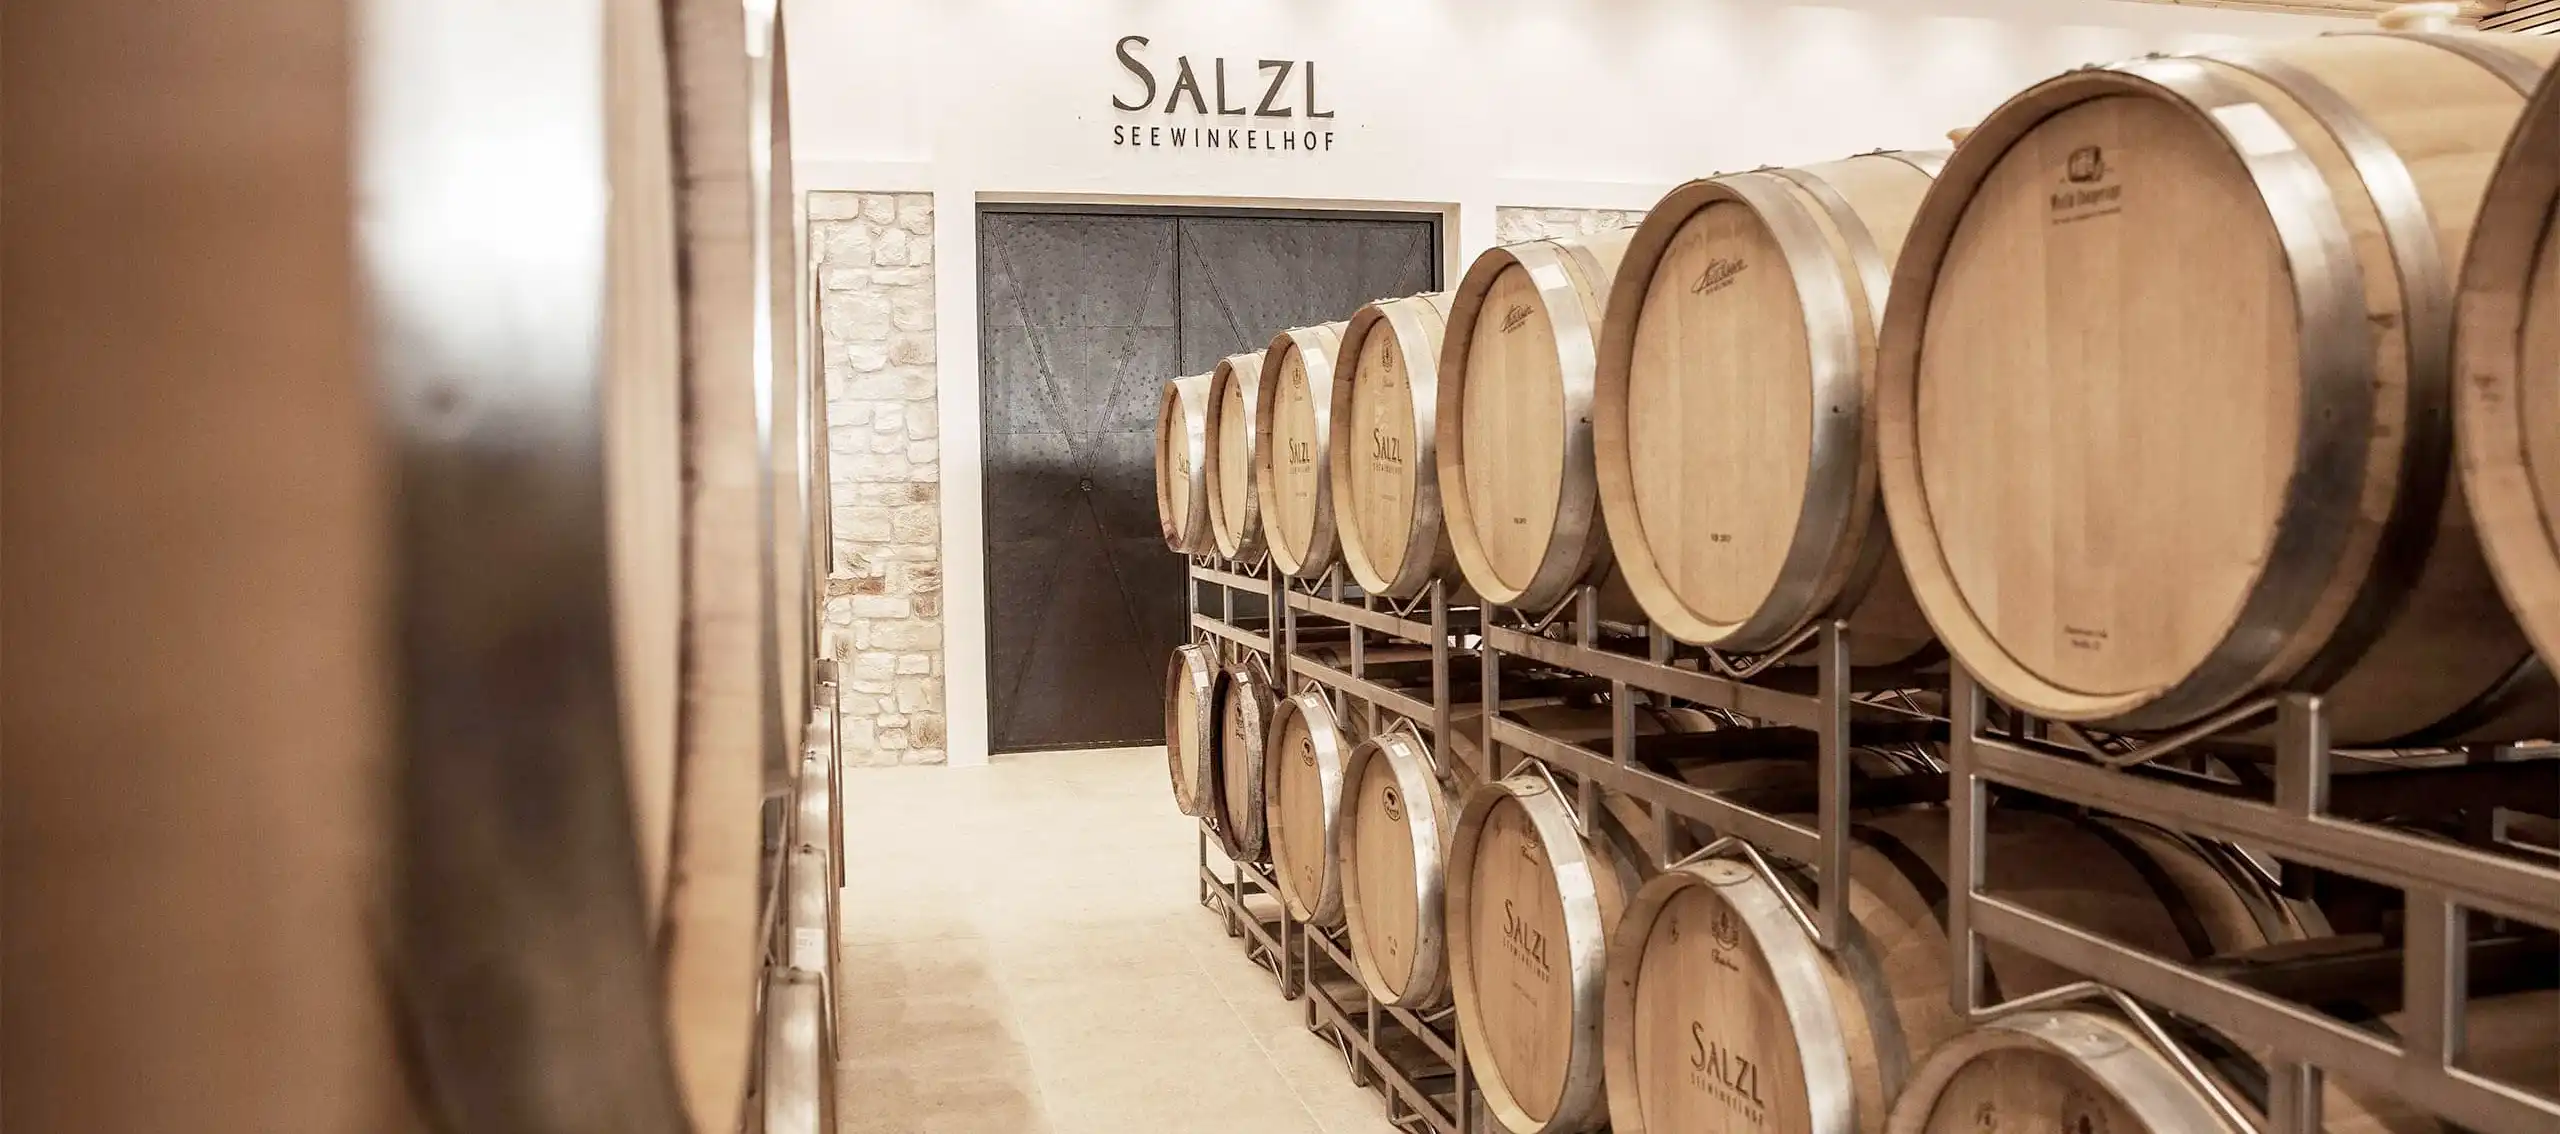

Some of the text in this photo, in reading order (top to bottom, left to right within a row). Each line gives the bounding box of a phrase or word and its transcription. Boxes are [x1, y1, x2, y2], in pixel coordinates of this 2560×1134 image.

[1112, 35, 1335, 118] SALZL
[1113, 125, 1335, 151] SEEWINKELHOF
[1373, 427, 1402, 464] SALZL
[1503, 898, 1550, 972] SALZL
[1690, 1020, 1766, 1109] SALZL
